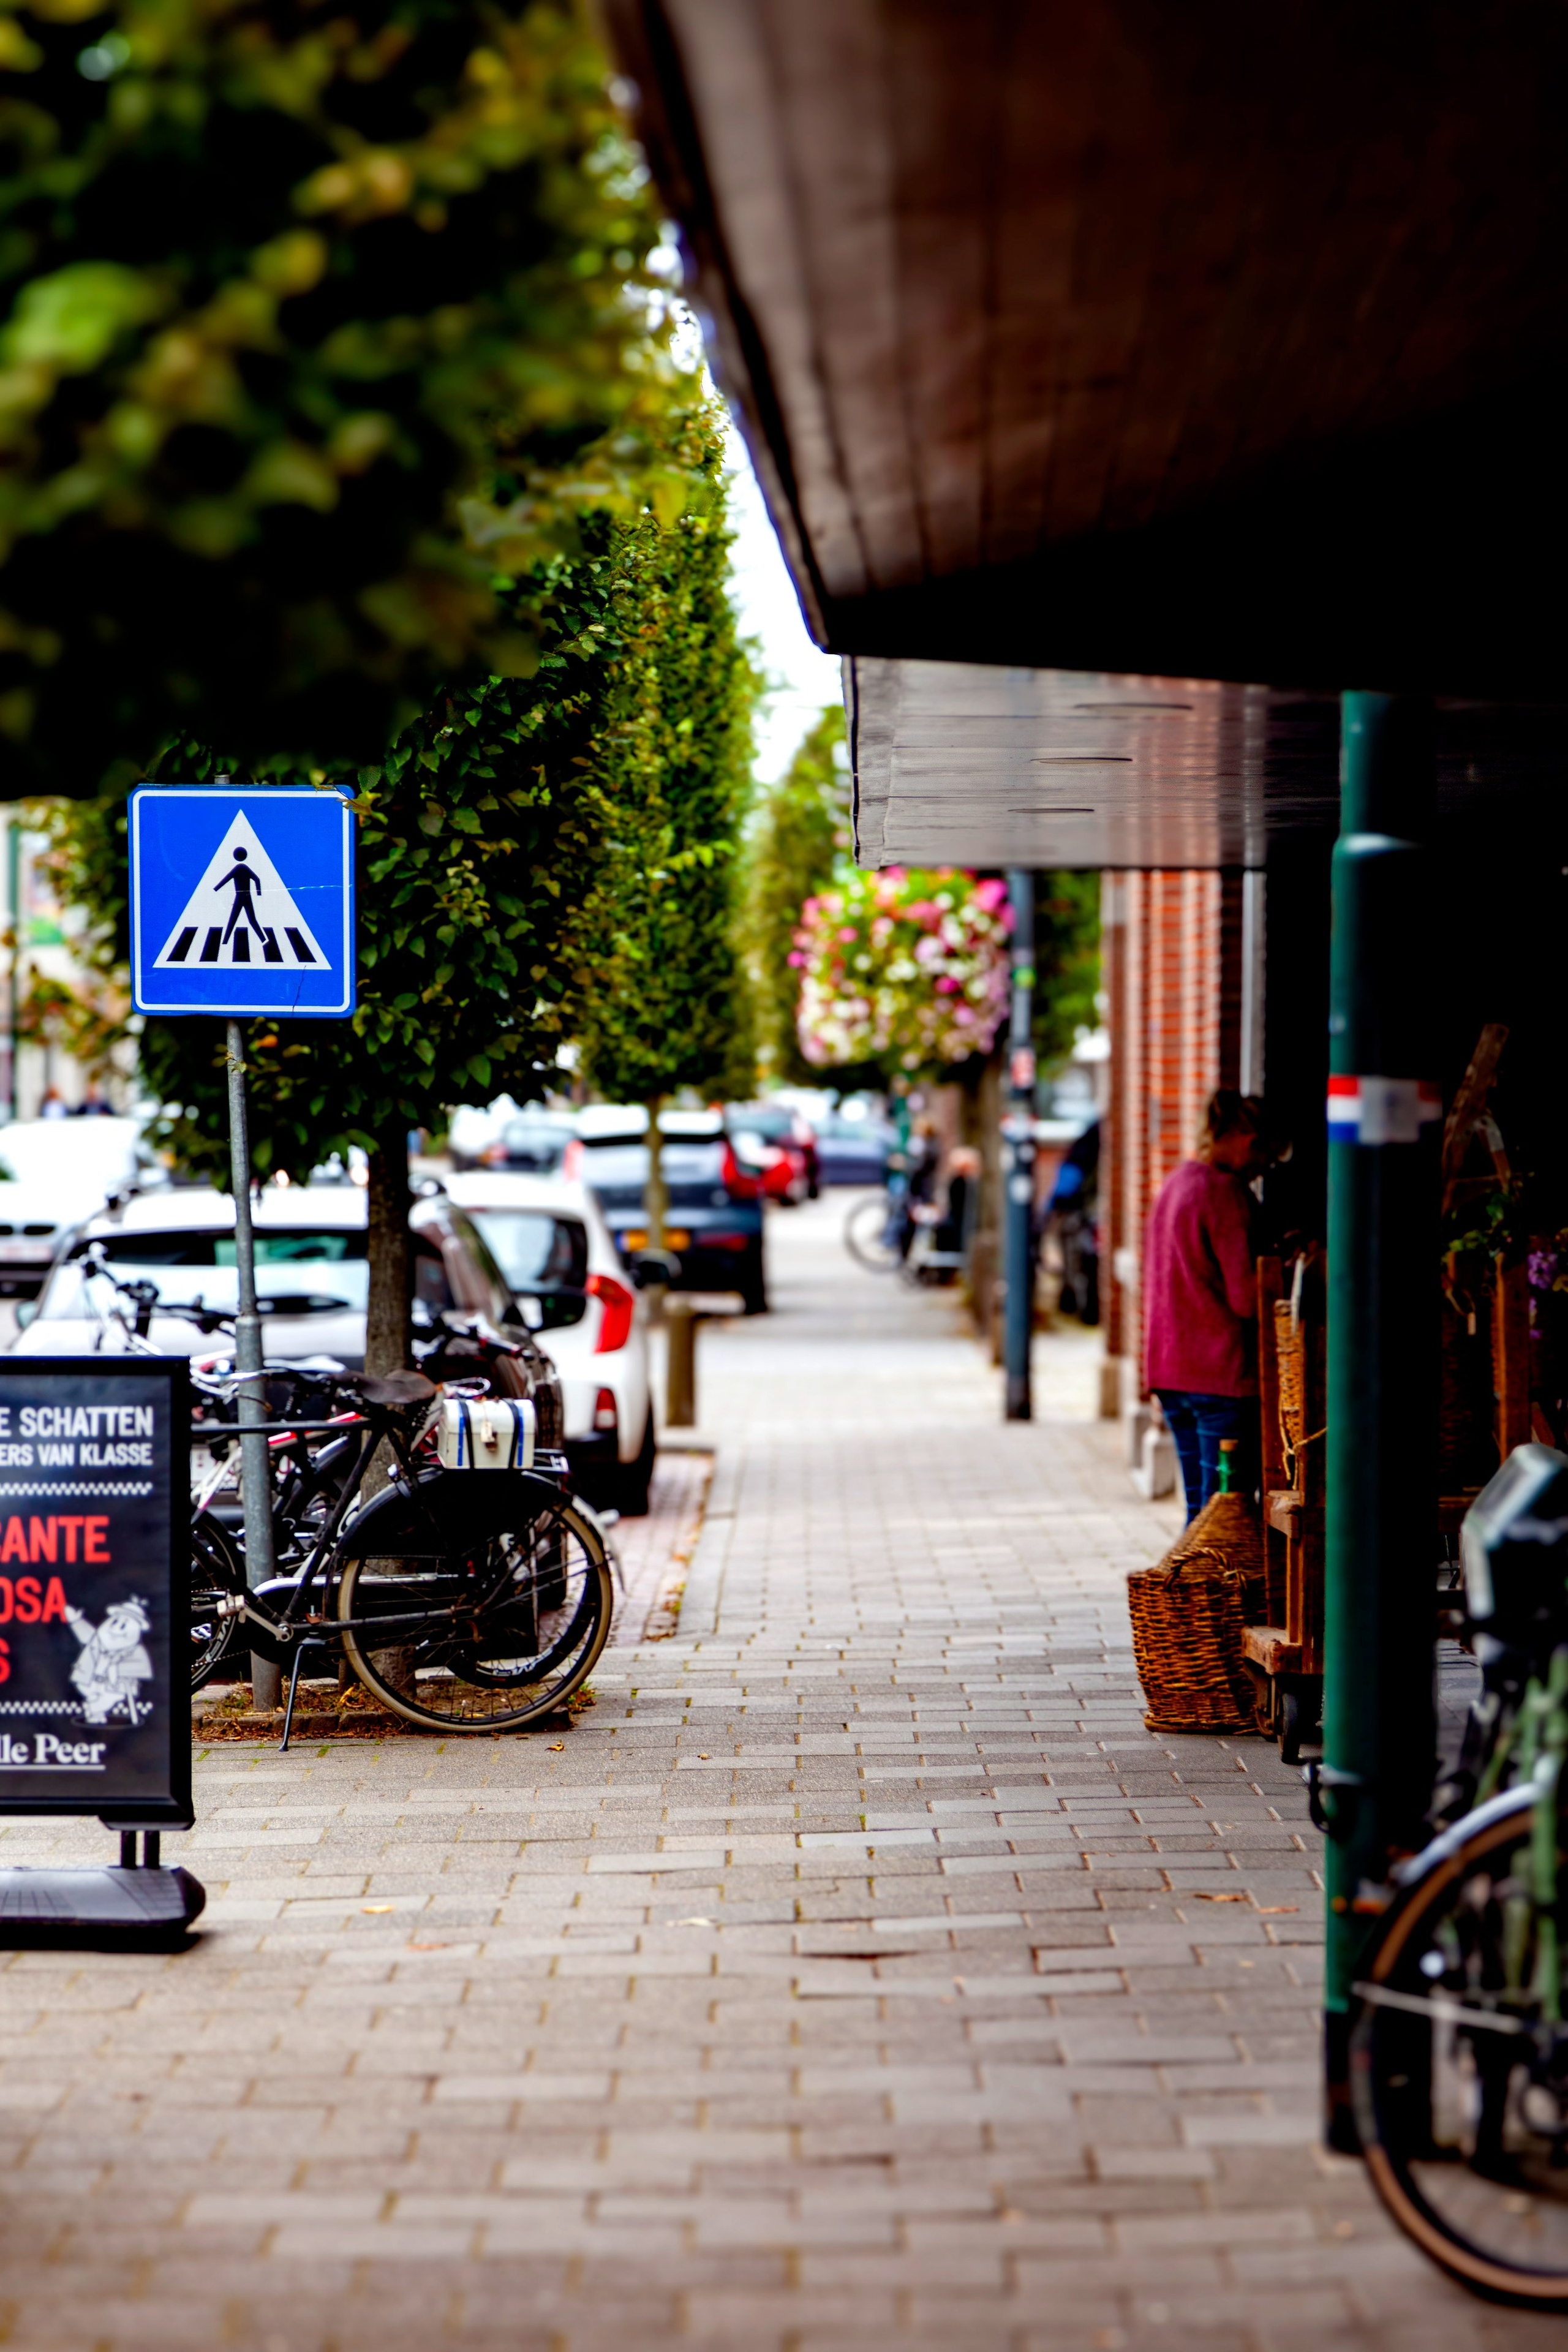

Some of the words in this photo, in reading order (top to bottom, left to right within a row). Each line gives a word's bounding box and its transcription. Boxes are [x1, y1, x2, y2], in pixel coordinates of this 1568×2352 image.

[19, 1406, 153, 1438] SCHATTEN
[37, 1443, 75, 1466] VAN
[79, 1442, 153, 1466] KLASSE
[0, 1515, 111, 1562] ANTE
[0, 1733, 29, 1764] le
[33, 1733, 107, 1764] Peer
